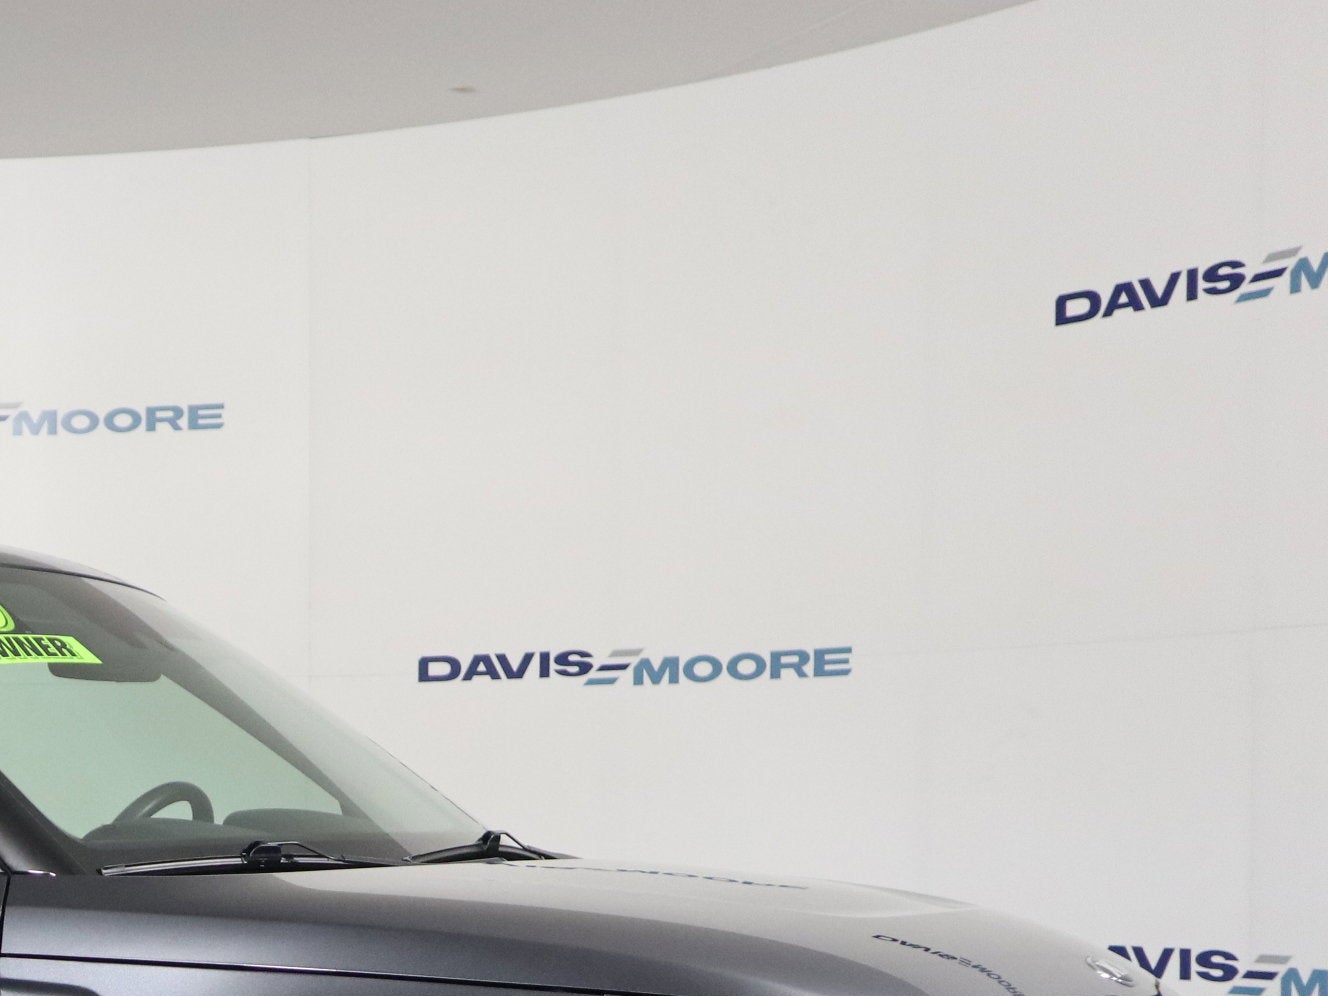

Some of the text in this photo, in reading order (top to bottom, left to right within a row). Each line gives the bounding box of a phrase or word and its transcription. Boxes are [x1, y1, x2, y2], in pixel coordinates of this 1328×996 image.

[1054, 259, 1246, 327] DAVIS
[12, 402, 225, 436] MOORE
[417, 646, 853, 686] DAVIS MOORE
